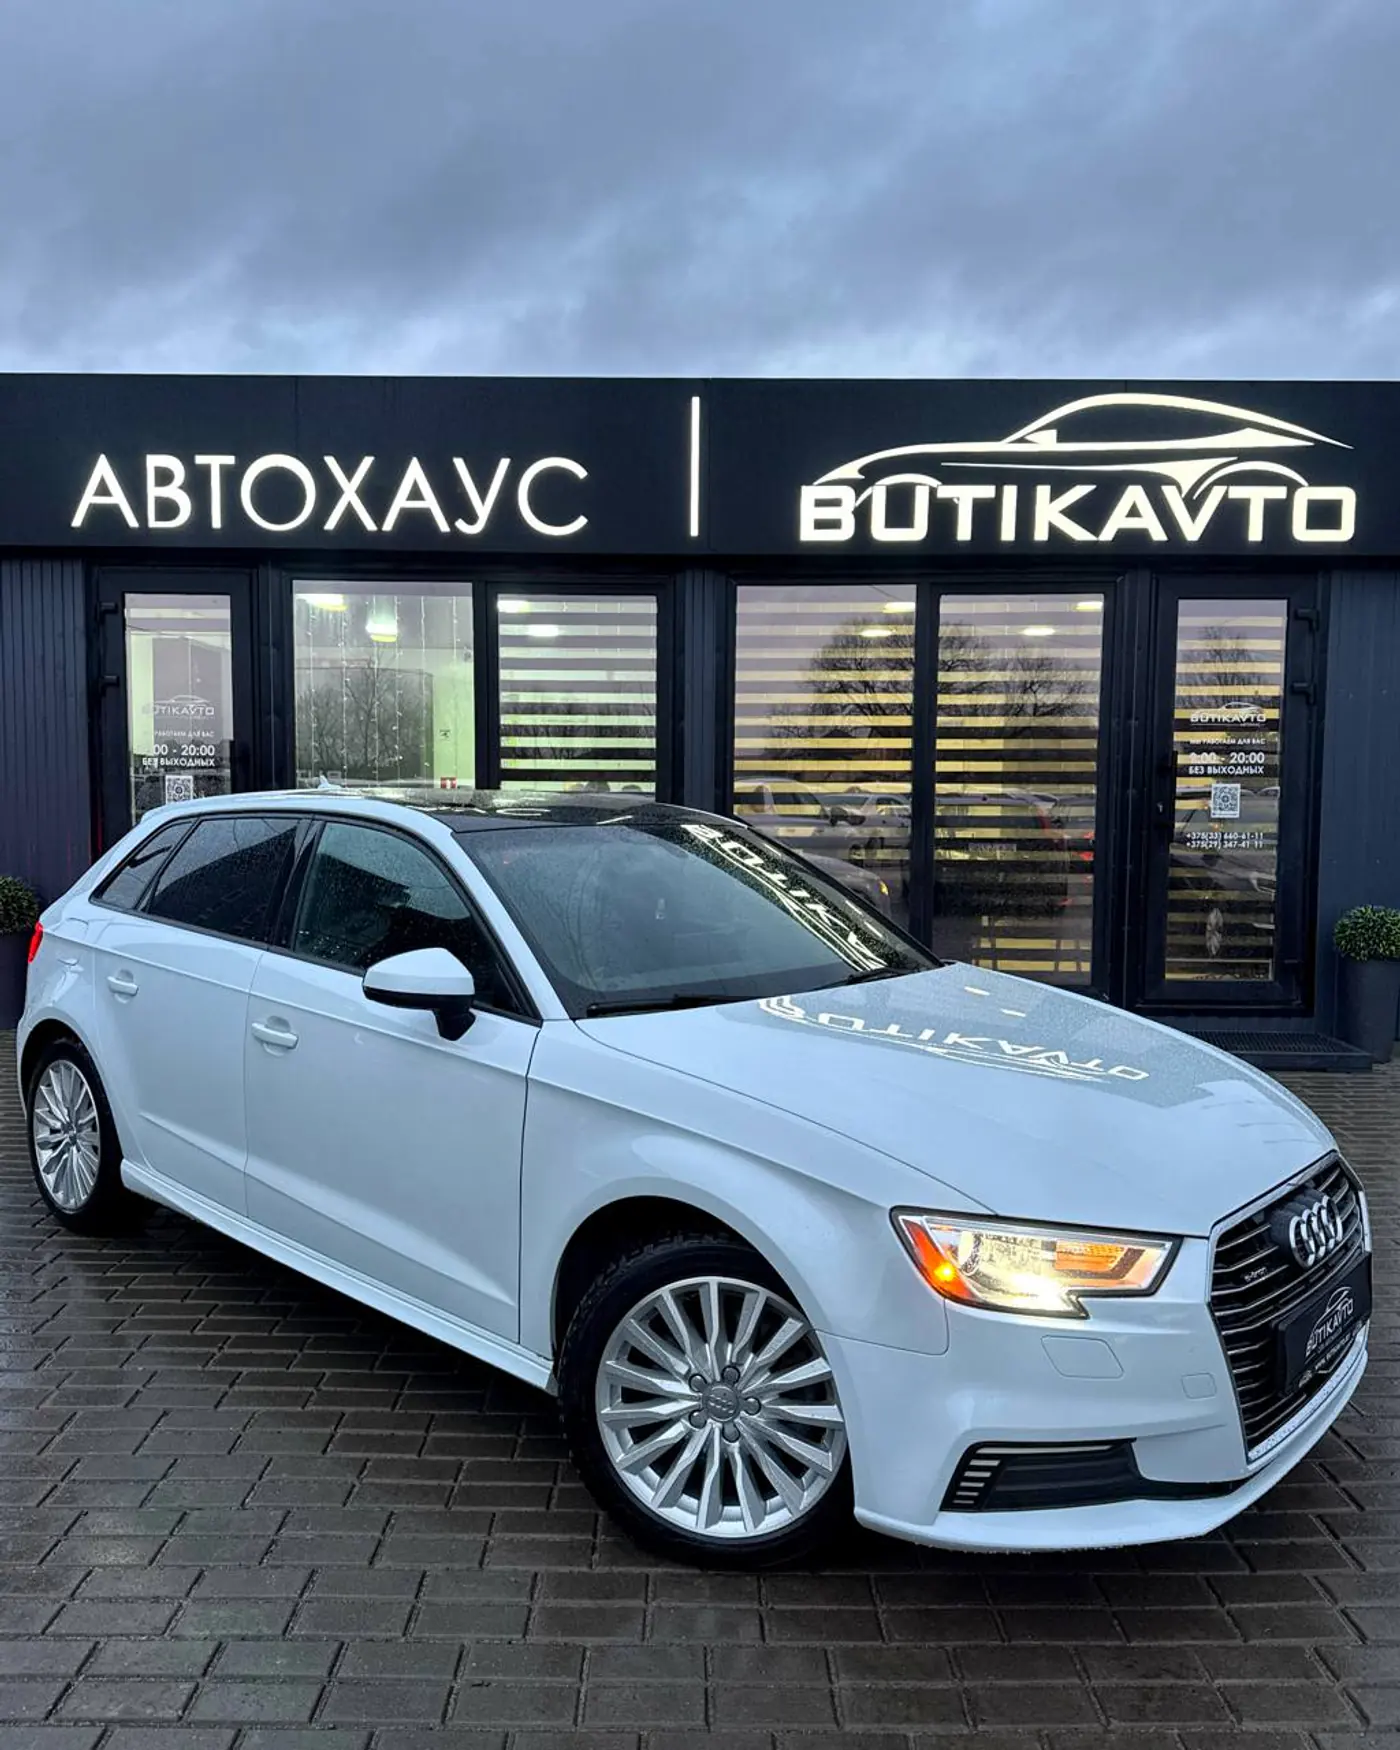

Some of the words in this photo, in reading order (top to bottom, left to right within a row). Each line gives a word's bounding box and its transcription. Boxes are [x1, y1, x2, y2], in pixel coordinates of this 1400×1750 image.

[71, 453, 589, 536] АВТОХАУС
[799, 484, 1356, 542] BUTIKAVTO
[142, 705, 215, 716] UTIKAVTO
[1190, 713, 1266, 722] BUTIKAVTO
[181, 744, 215, 756] 20:00
[160, 757, 215, 767] ВЫХОДНЫХ
[1229, 752, 1265, 764] 20:00
[1188, 765, 1205, 775] БЕЗ
[1207, 765, 1265, 775] ВЫХОДНЫХ
